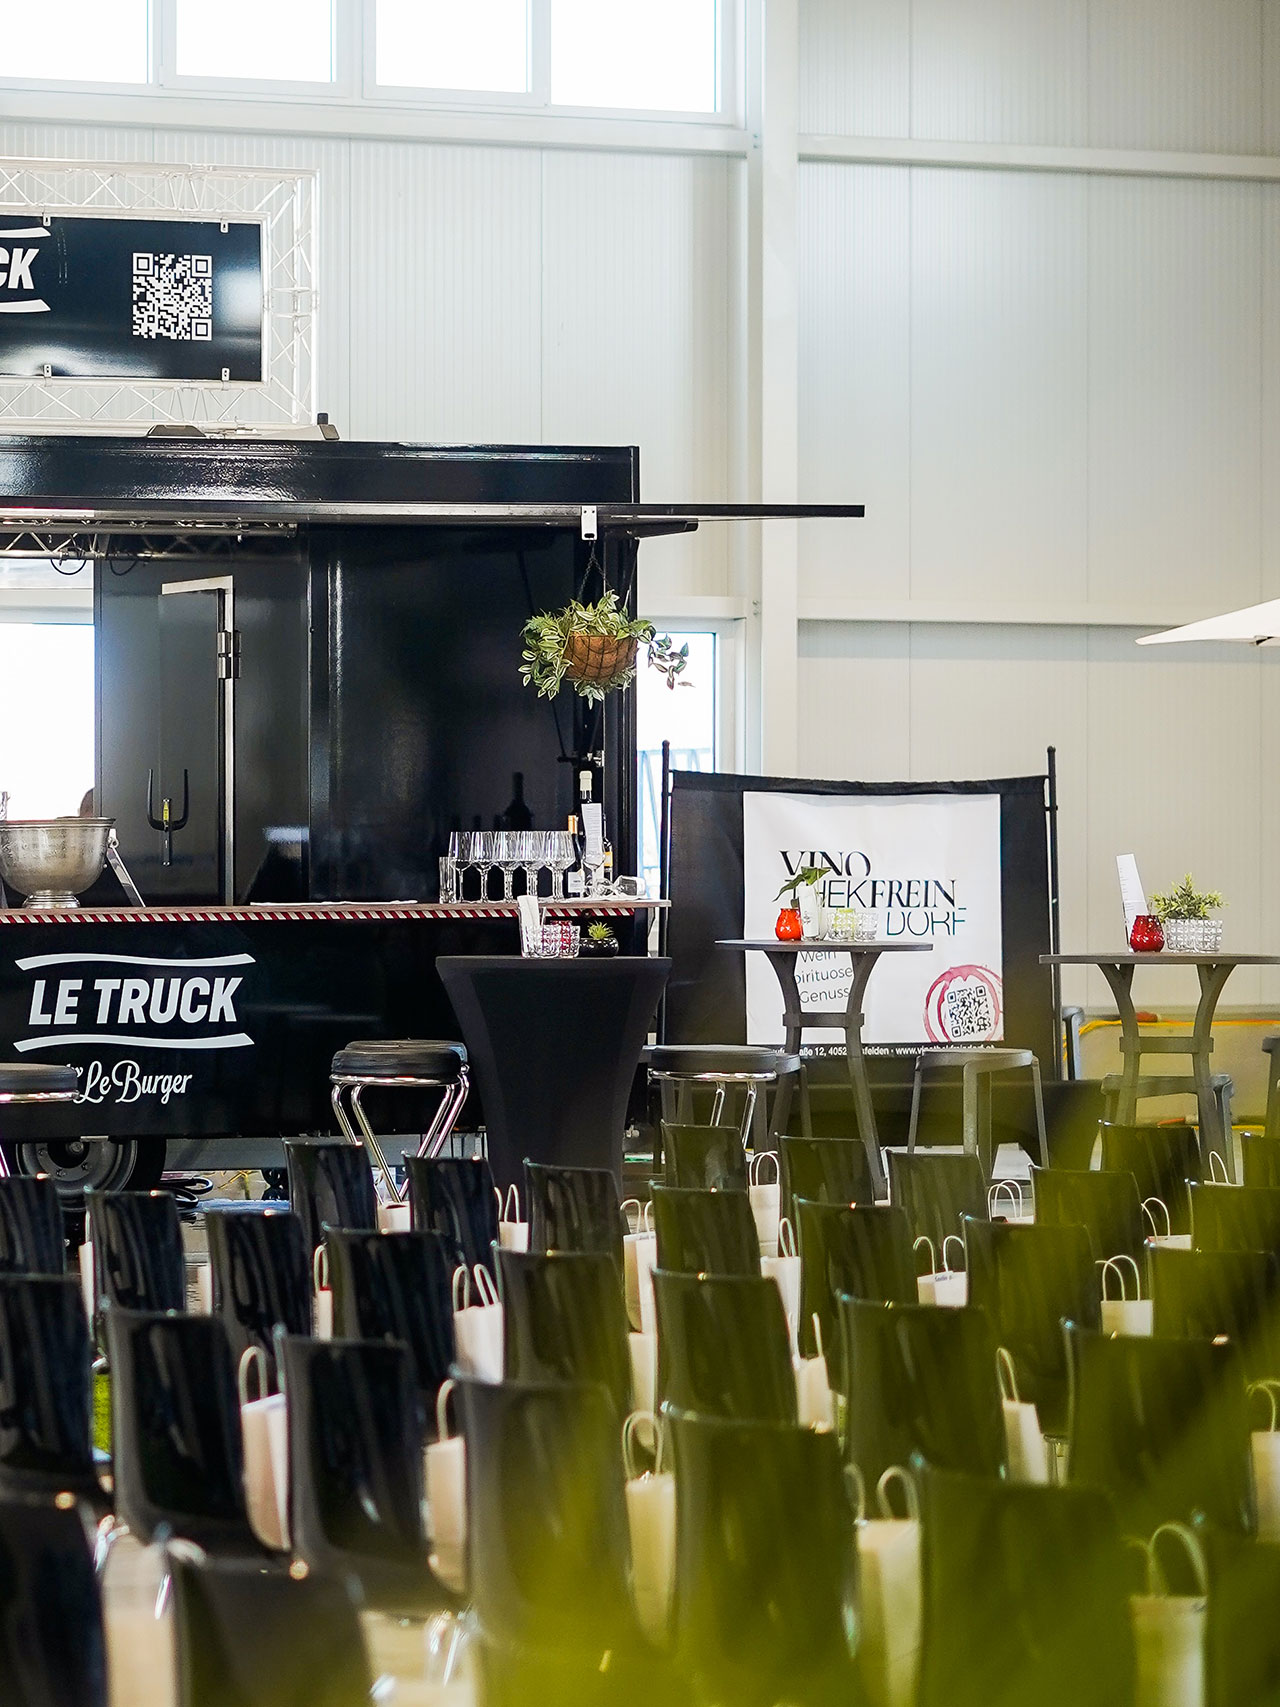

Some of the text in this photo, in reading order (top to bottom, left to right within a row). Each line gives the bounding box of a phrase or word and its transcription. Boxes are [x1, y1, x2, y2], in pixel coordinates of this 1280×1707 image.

[779, 850, 872, 877] VINO
[886, 907, 967, 936] DORF
[793, 966, 854, 985] pirituose
[28, 976, 244, 1025] LE TRUCK
[799, 987, 850, 1004] Genuss
[828, 1046, 848, 1056] 4052
[72, 1060, 112, 1104] Le
[111, 1059, 193, 1105] Burger
